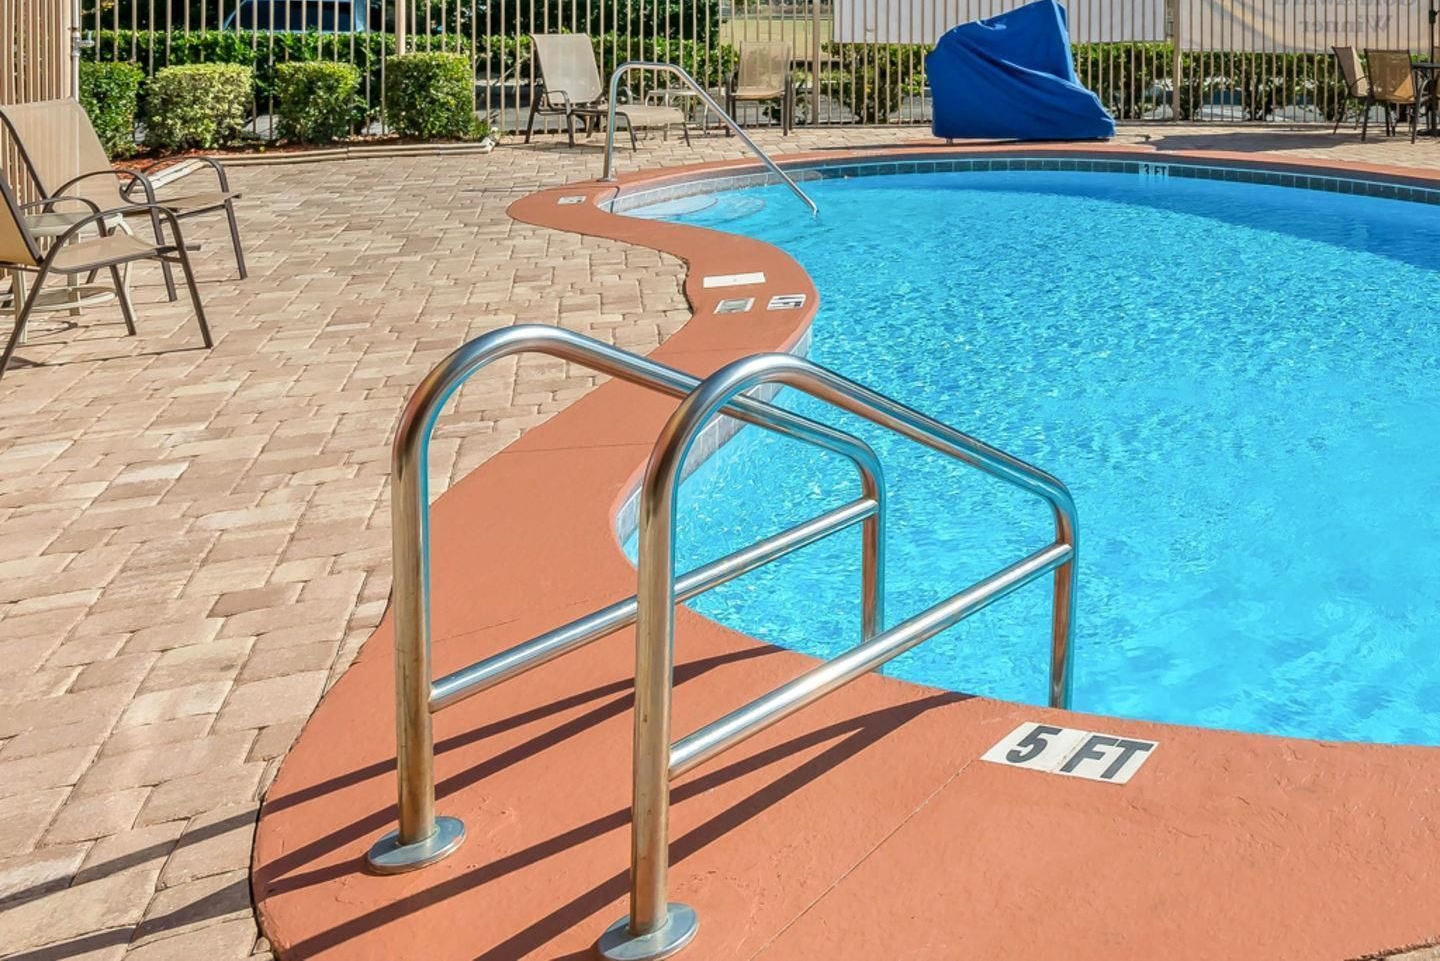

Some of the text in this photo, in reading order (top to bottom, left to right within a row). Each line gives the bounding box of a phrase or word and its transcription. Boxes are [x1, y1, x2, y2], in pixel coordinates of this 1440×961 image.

[1154, 166, 1166, 176] FT
[1005, 725, 1155, 779] 5 FT
